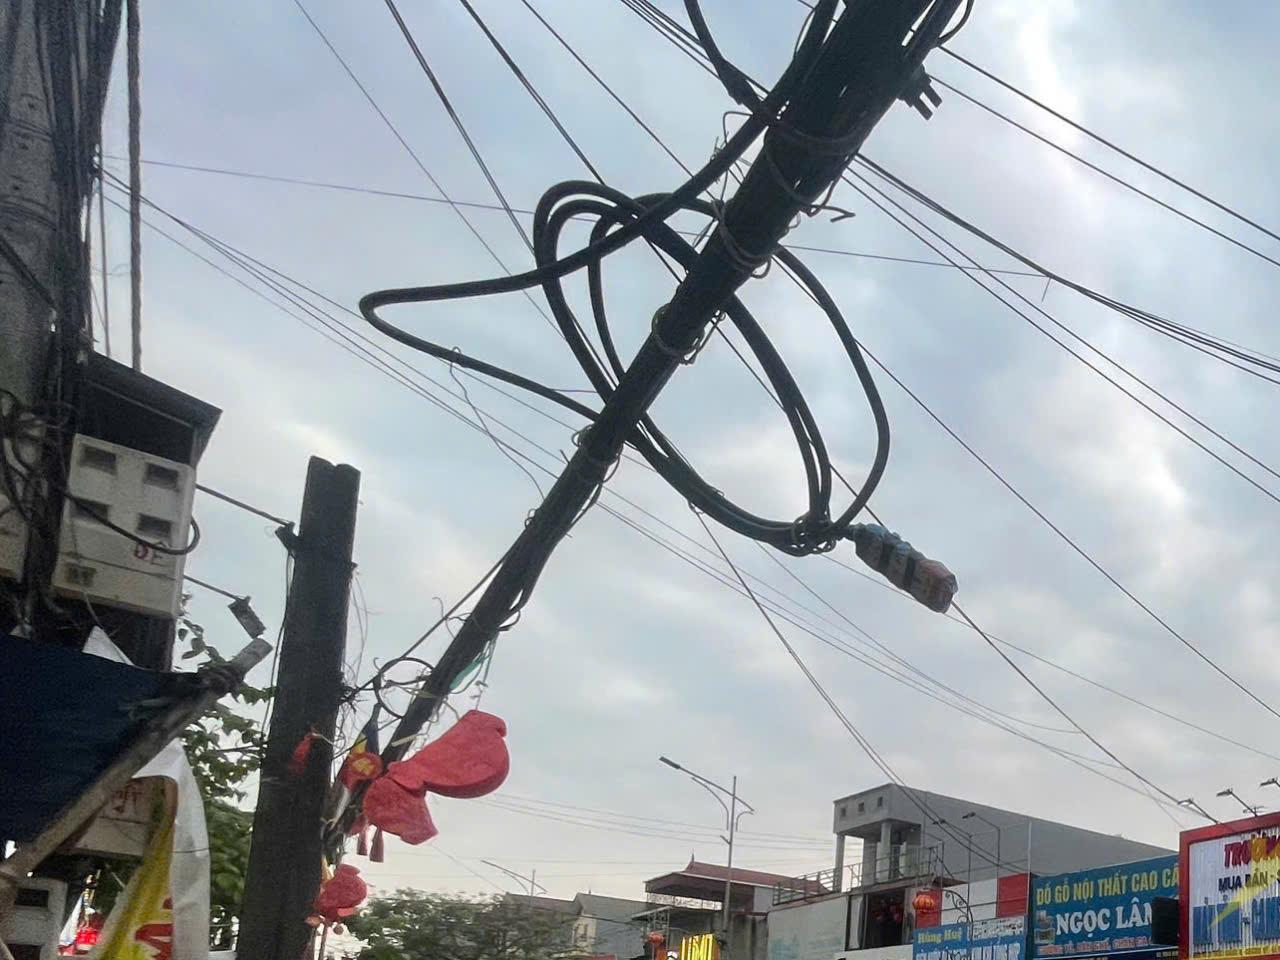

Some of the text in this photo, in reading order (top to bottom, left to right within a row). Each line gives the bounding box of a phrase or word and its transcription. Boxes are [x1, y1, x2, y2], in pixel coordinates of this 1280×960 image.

[1073, 877, 1094, 903] NỘI
[1097, 869, 1128, 897] THẤT
[1131, 870, 1158, 892] CAO
[1219, 876, 1242, 891] MUA
[1245, 868, 1268, 887] BÁN
[1056, 908, 1111, 938] NGỌC
